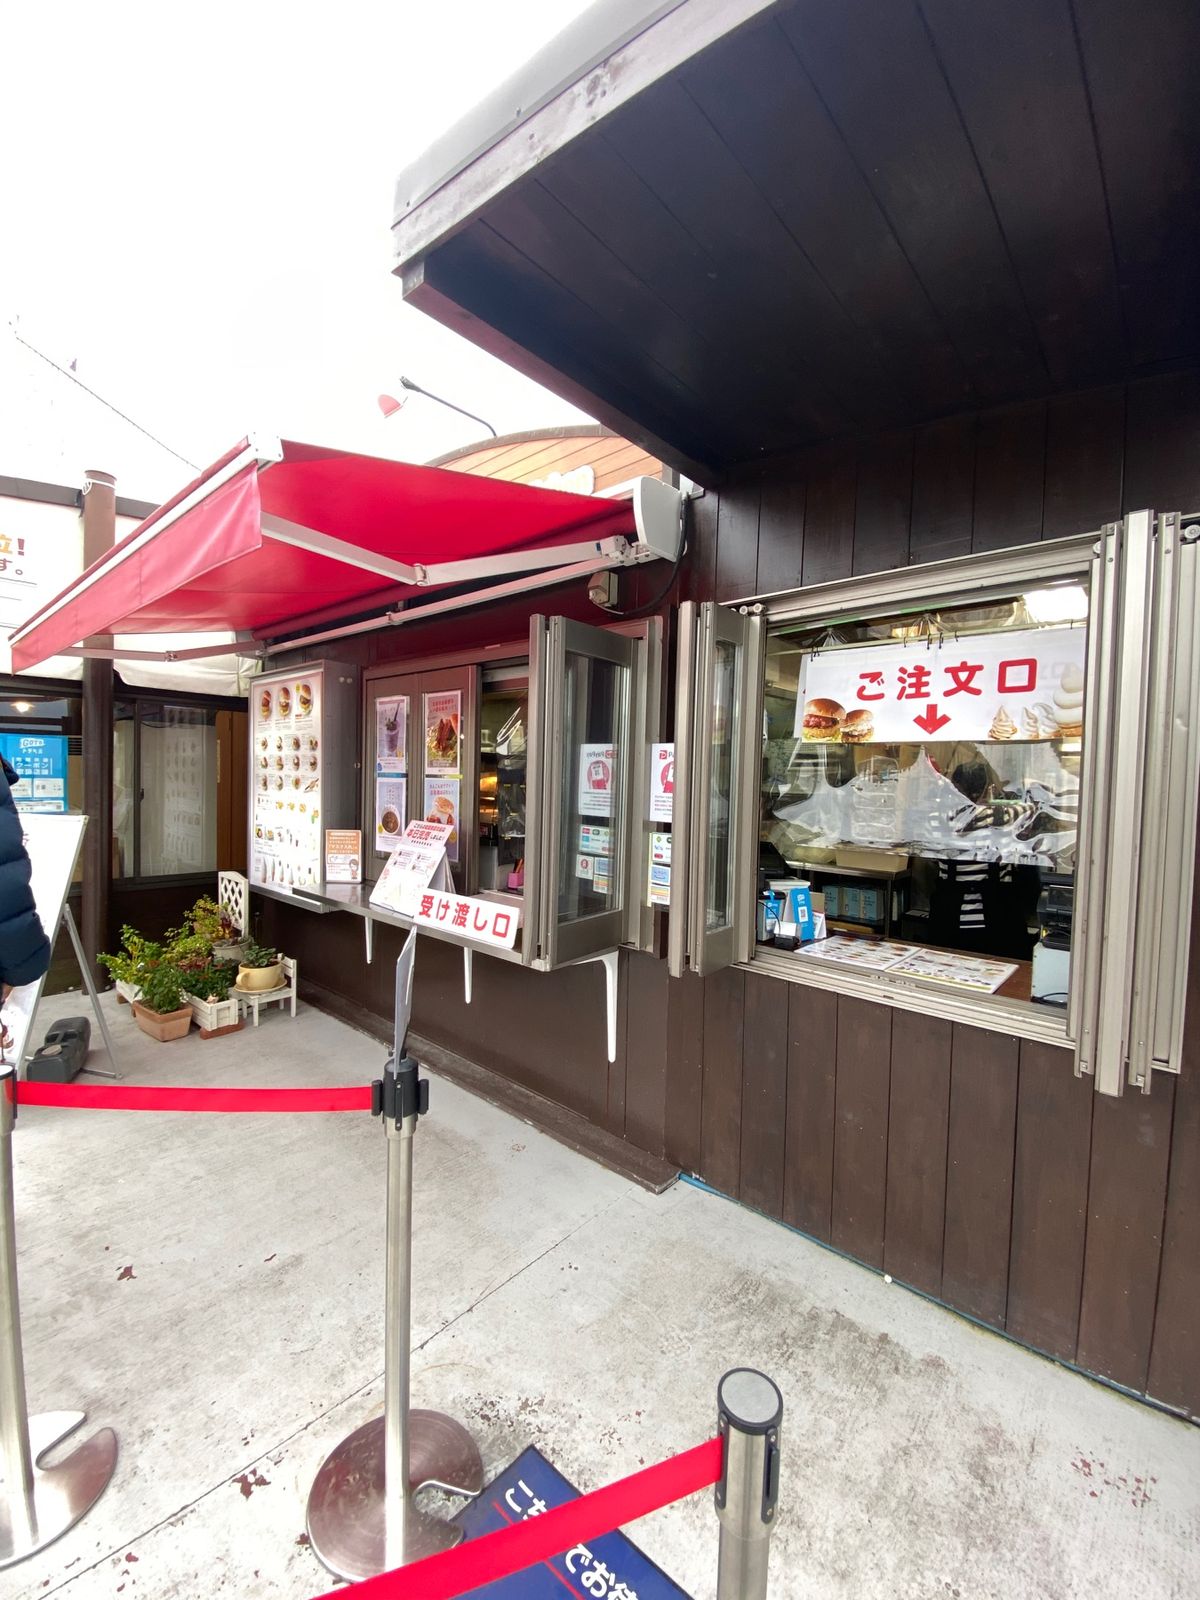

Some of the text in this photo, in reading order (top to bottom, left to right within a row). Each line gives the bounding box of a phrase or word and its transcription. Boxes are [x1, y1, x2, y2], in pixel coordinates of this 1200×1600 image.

[857, 658, 1037, 702] ご注文口
[419, 894, 511, 938] 受け渡し口
